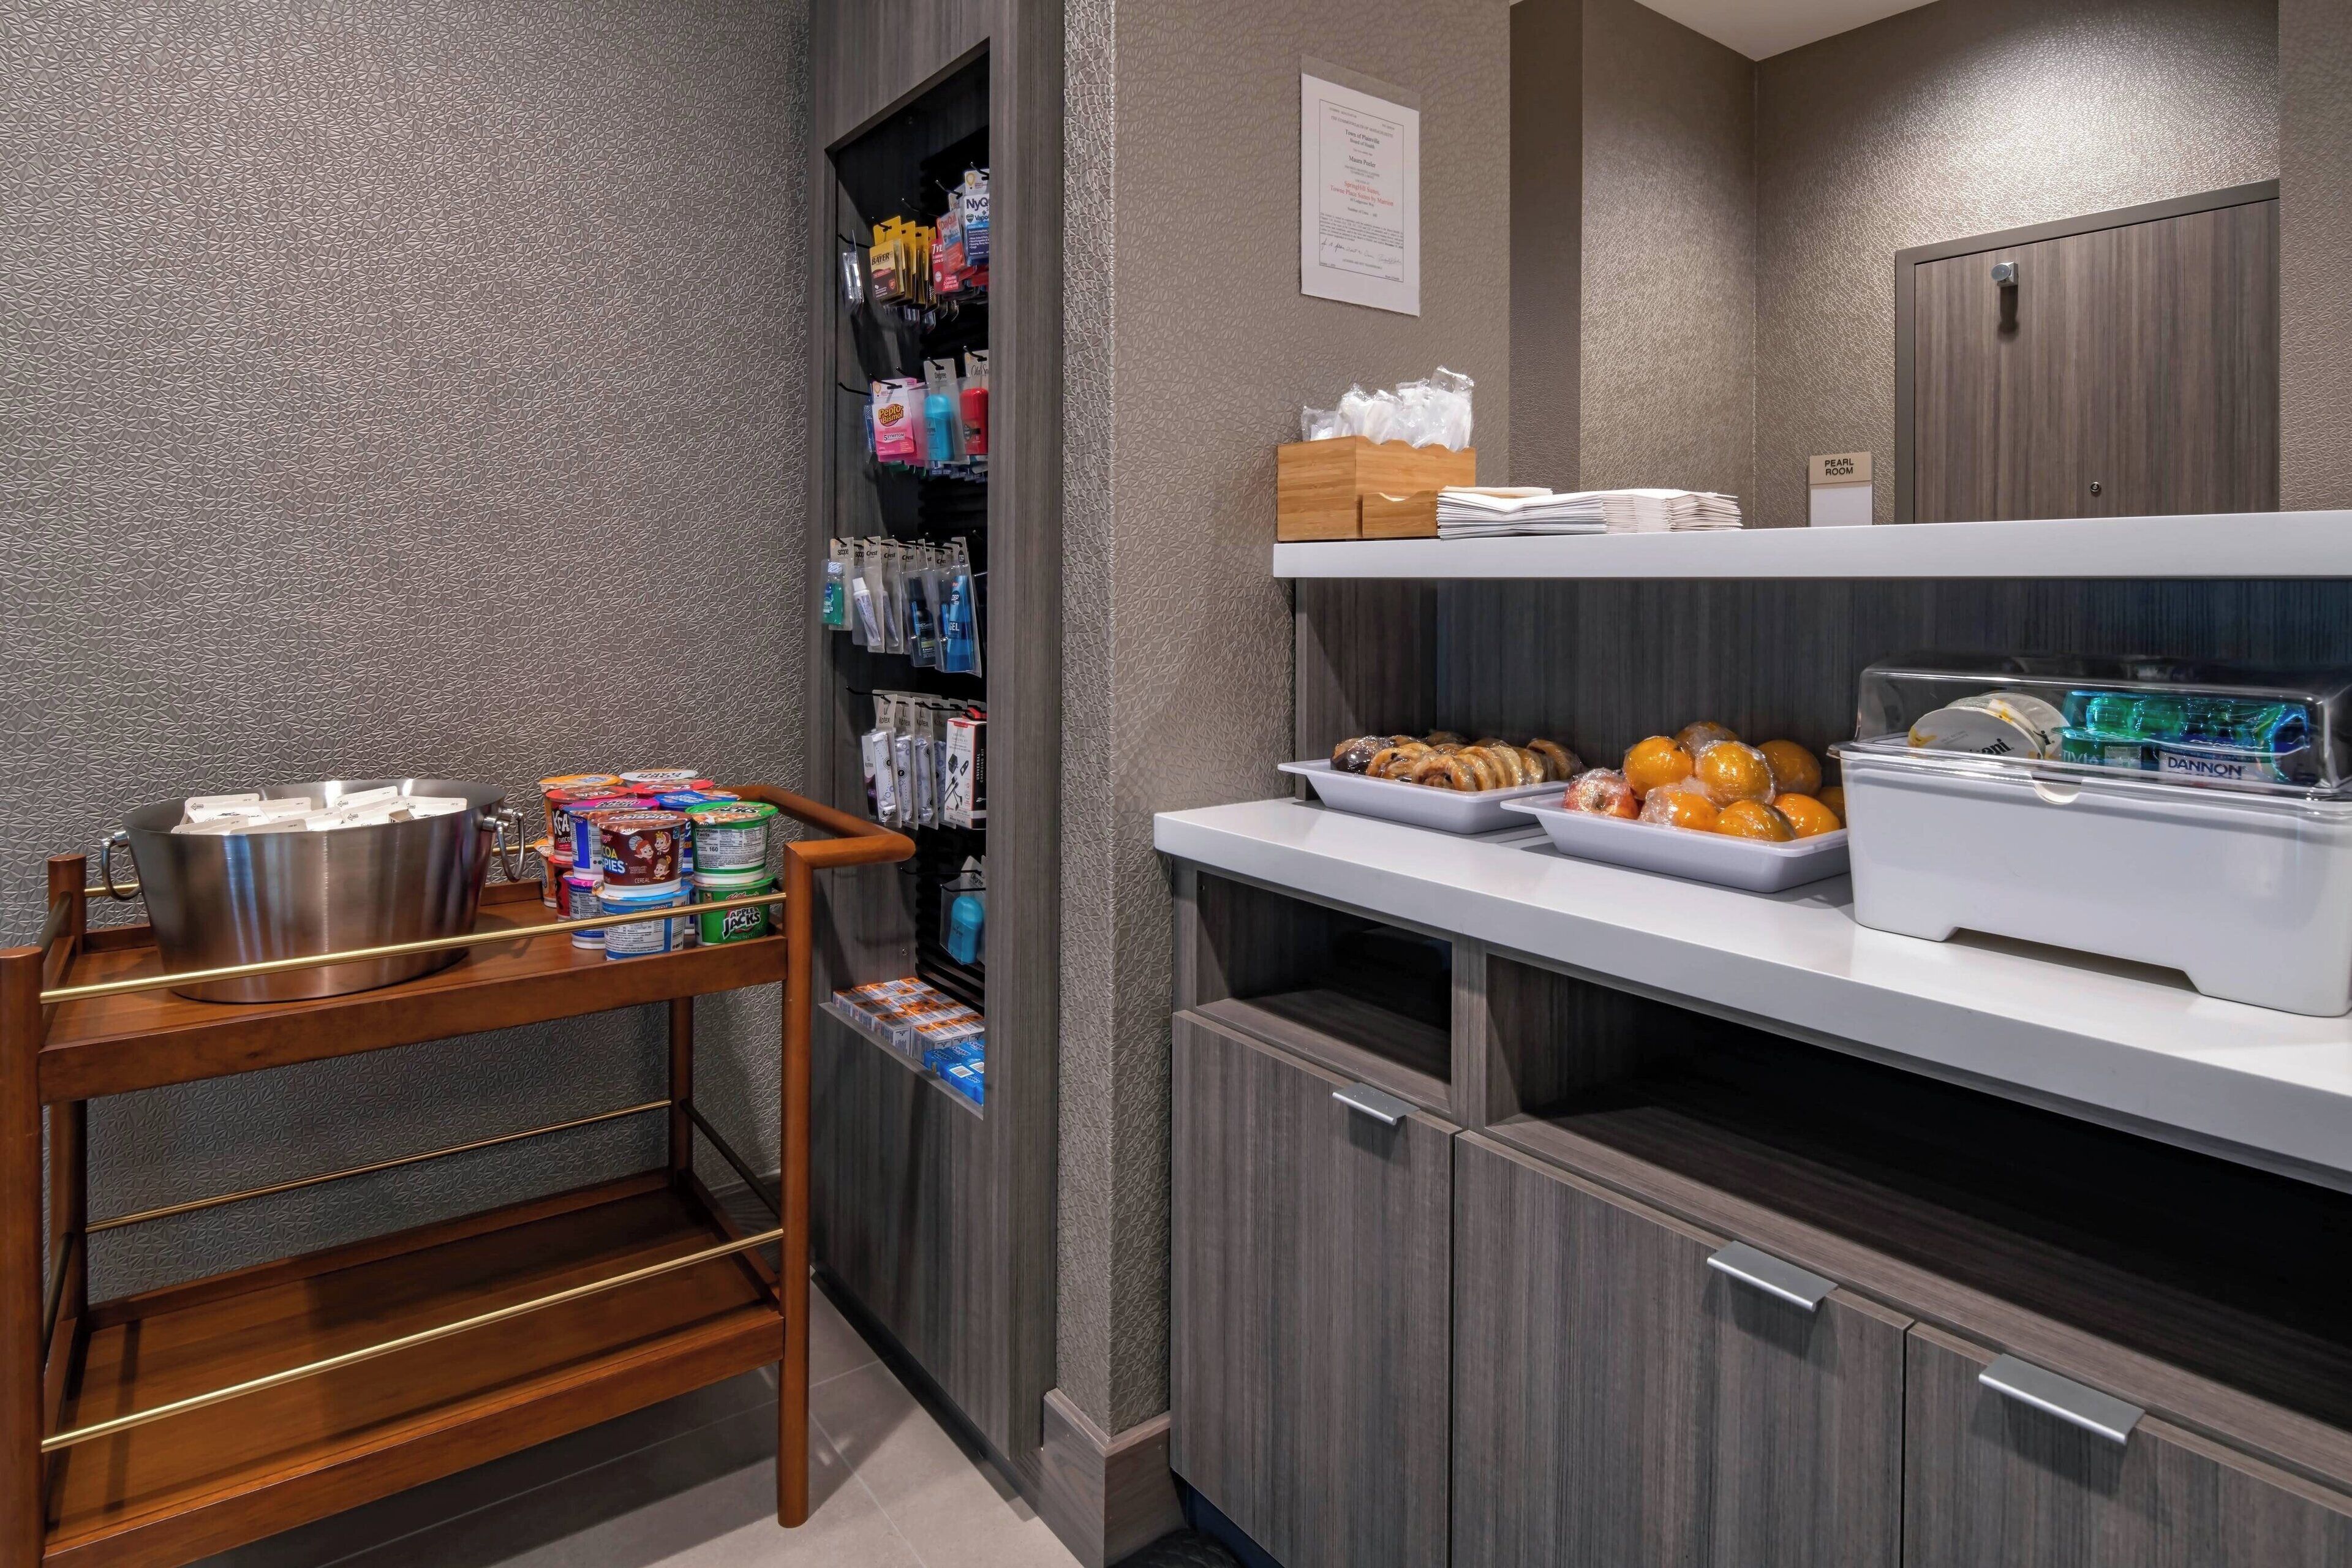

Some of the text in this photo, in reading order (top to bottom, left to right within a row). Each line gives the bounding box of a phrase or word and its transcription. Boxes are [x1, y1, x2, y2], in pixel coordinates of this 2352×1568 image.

[1348, 155, 1363, 165] Maura
[966, 197, 989, 211] NyQ
[872, 252, 890, 265] BAYER
[878, 405, 903, 419] Pepto-
[881, 410, 903, 424] Bismol
[1825, 458, 1854, 467] PEARL
[1825, 467, 1853, 476] ROOM
[949, 622, 960, 631] GEL
[2168, 756, 2242, 777] DANNON
[729, 907, 755, 919] APPLE
[722, 911, 761, 940] JACKS
